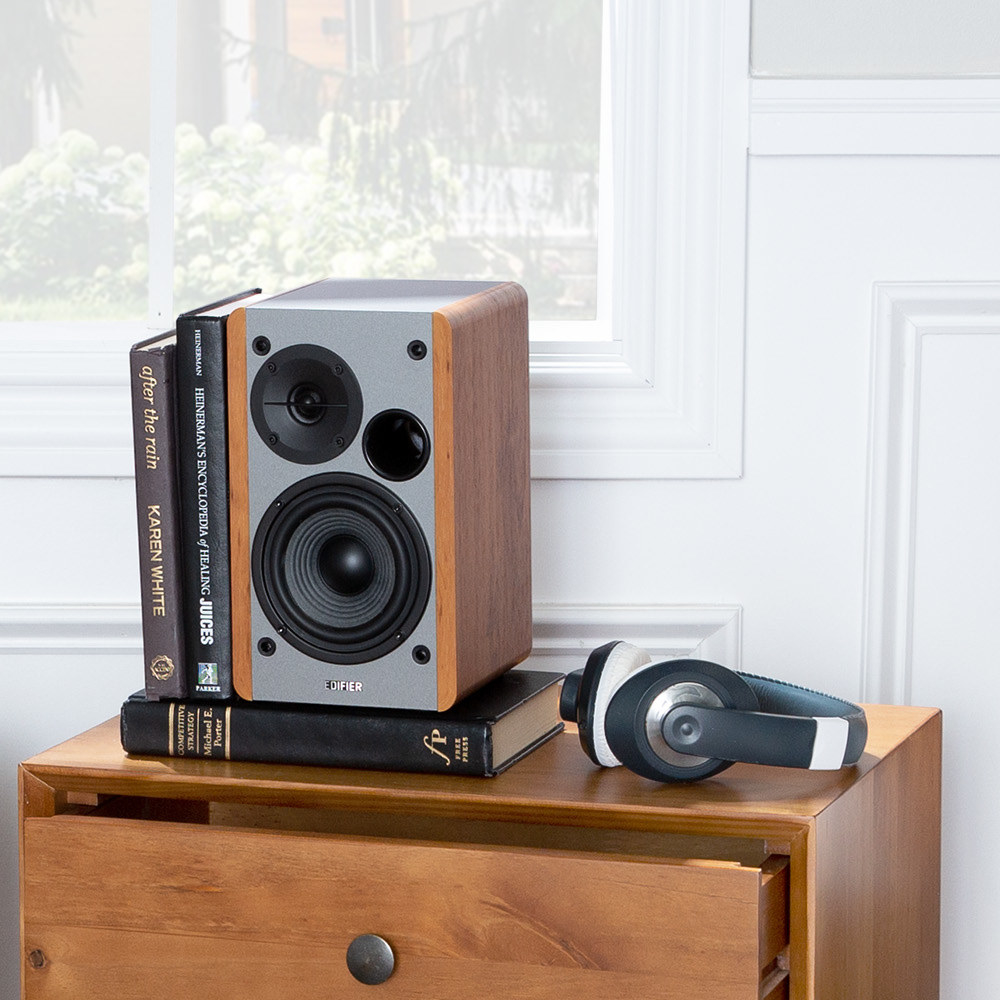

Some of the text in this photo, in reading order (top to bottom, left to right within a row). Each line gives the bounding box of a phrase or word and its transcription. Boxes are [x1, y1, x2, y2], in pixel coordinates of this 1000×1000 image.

[194, 329, 203, 377] HEINERMAN
[139, 365, 160, 470] after the rain
[195, 388, 214, 646] HEINERMAN'S ENCYCLOPEDIA of HEALING JUICES
[147, 505, 166, 617] KAREN WHITE
[325, 680, 363, 692] EDIFIER
[177, 704, 186, 756] COMPETITIVE
[187, 711, 195, 751] STRATEGY
[203, 707, 212, 756] Michael E.
[213, 718, 223, 747] Porter
